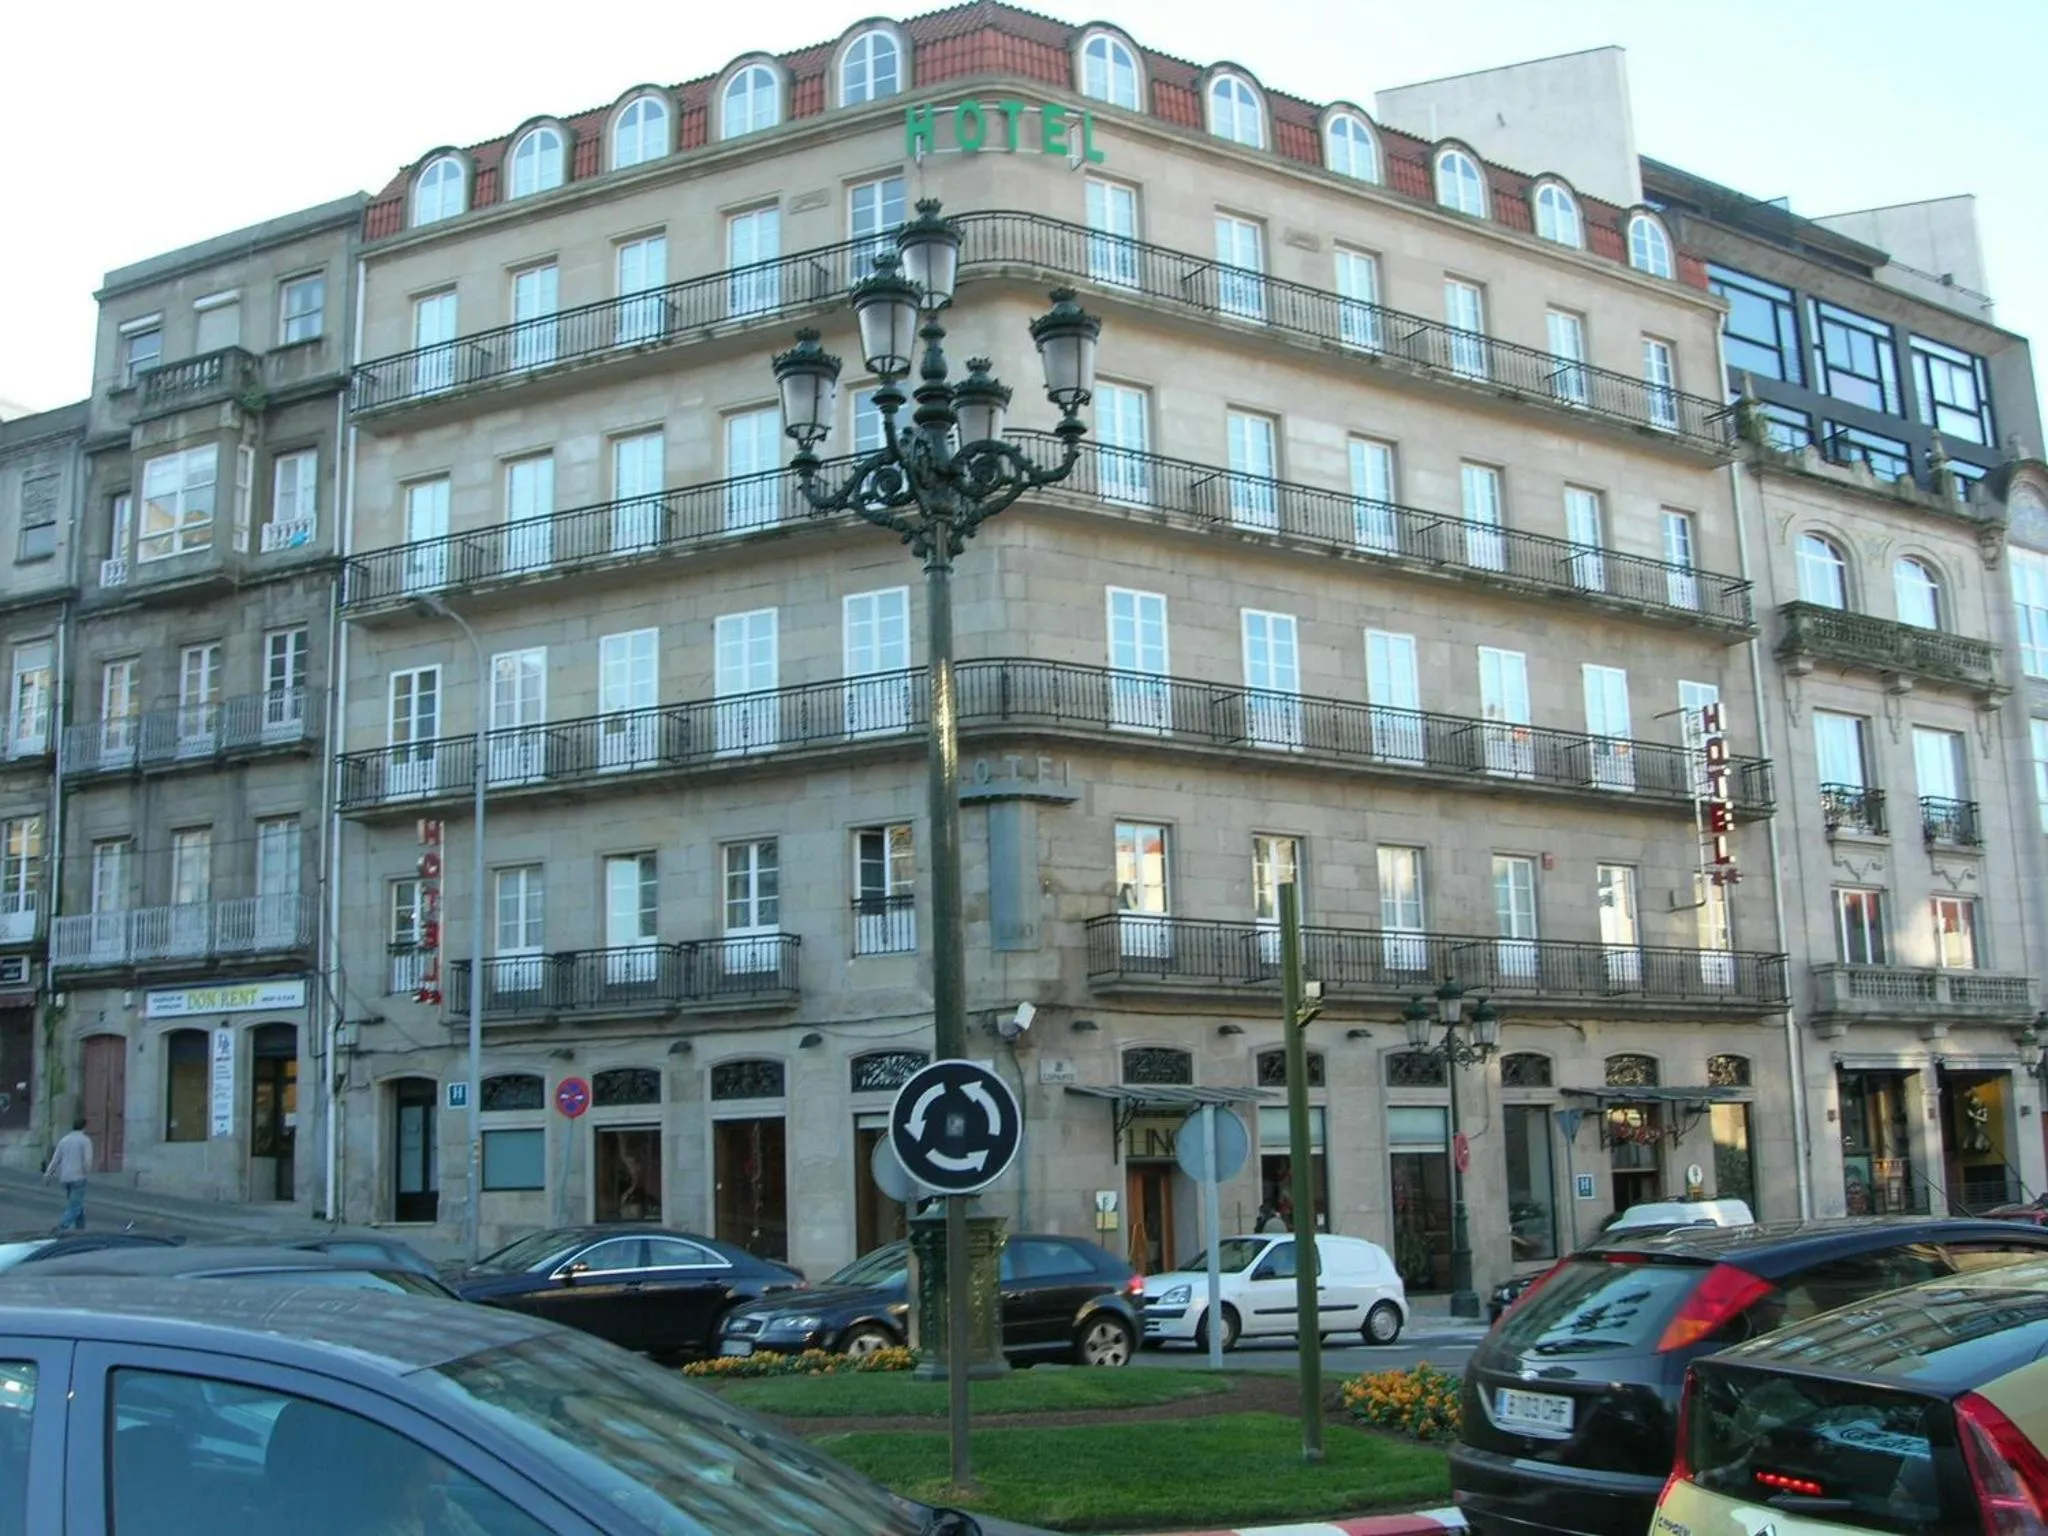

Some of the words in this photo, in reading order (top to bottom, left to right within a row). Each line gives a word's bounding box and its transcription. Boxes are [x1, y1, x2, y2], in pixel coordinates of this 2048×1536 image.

[906, 97, 1104, 164] HOTEL
[1703, 702, 1737, 865] HOTEL
[416, 817, 444, 982] HOTEL
